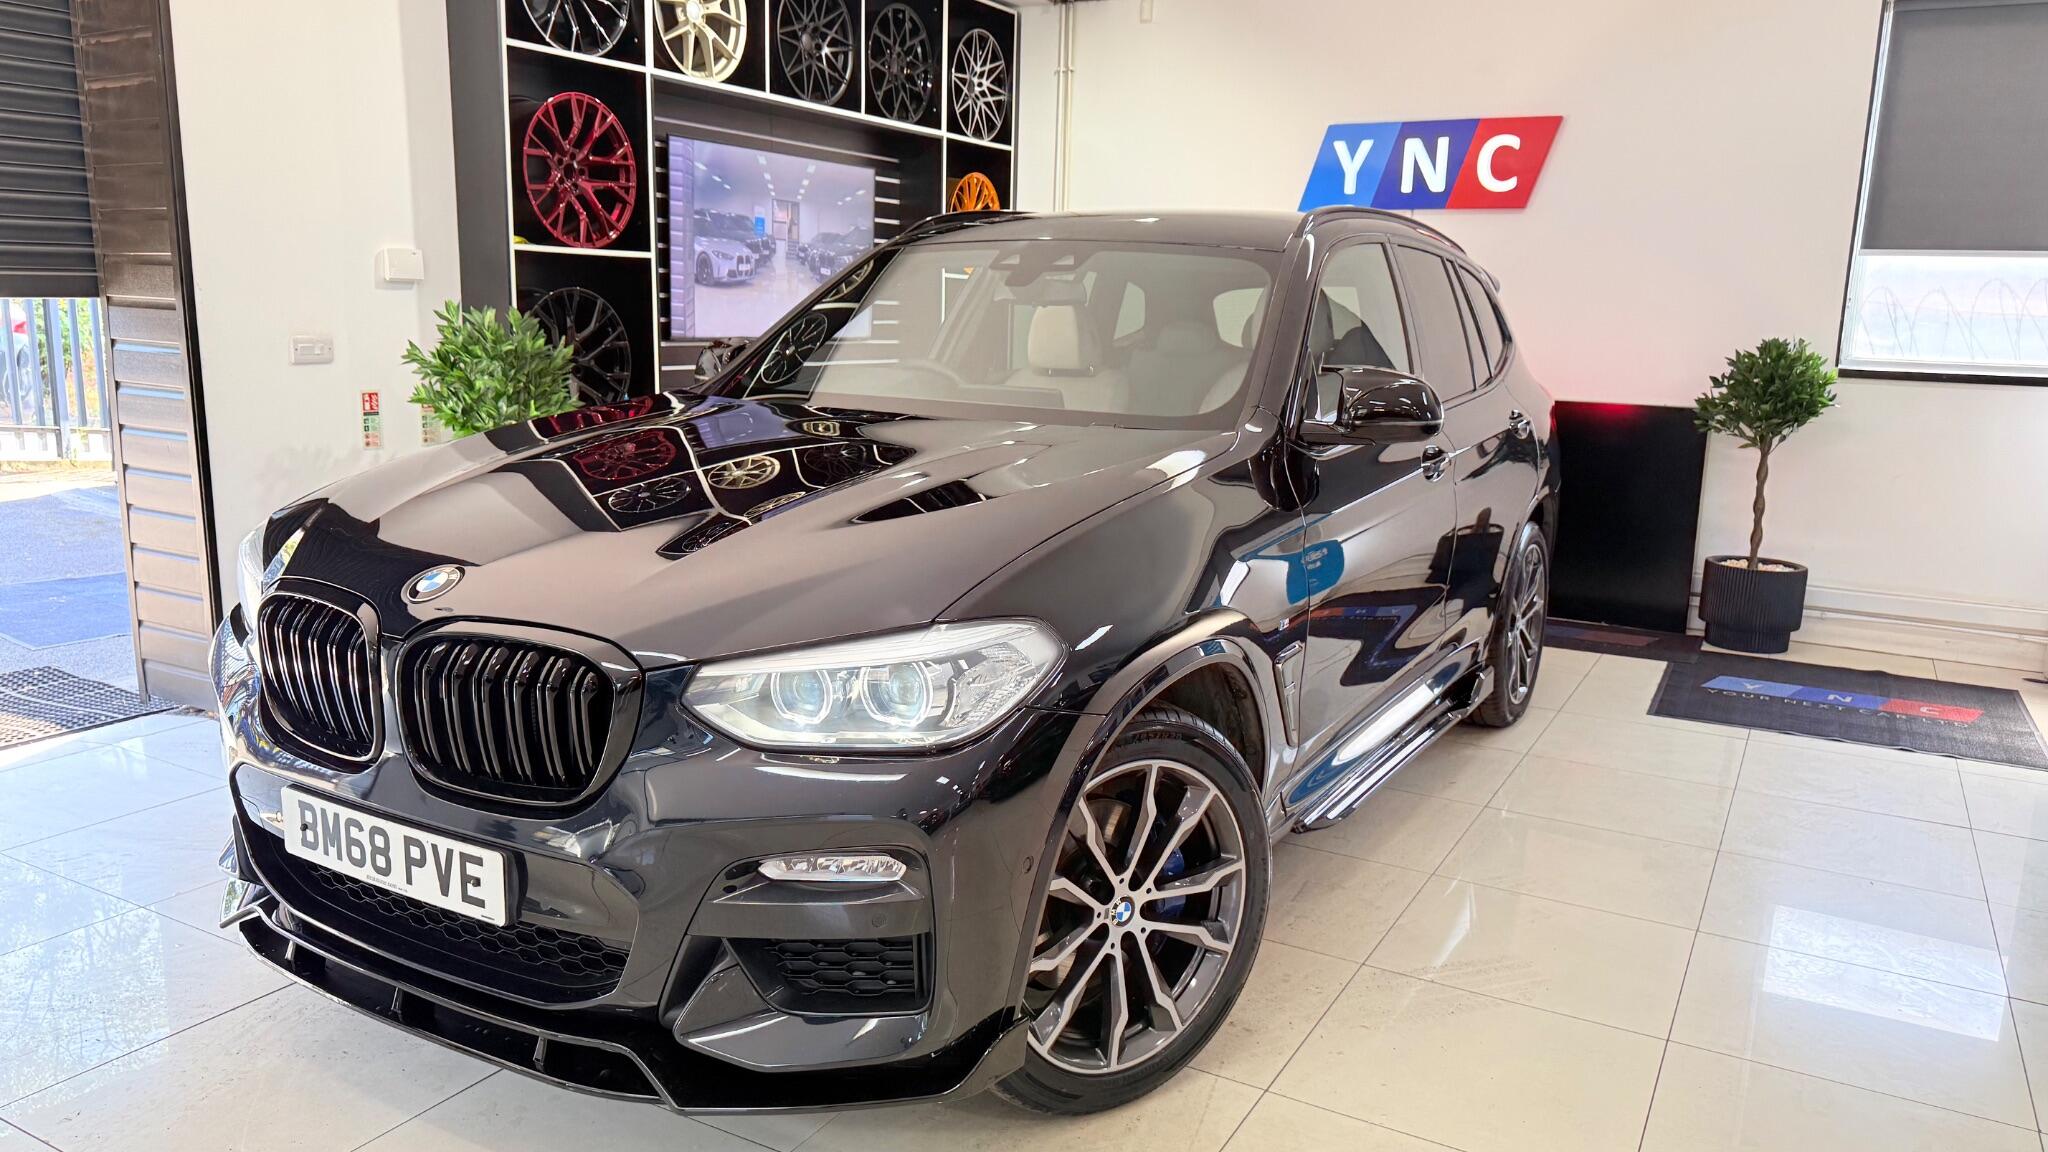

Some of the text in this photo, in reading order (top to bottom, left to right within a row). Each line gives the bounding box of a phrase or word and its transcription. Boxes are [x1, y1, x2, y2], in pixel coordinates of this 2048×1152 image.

[1707, 688, 1770, 701] YOUR
[1784, 699, 1846, 711] NEXT
[1859, 709, 1907, 720] CAR
[298, 800, 486, 909] BM68 PVE
